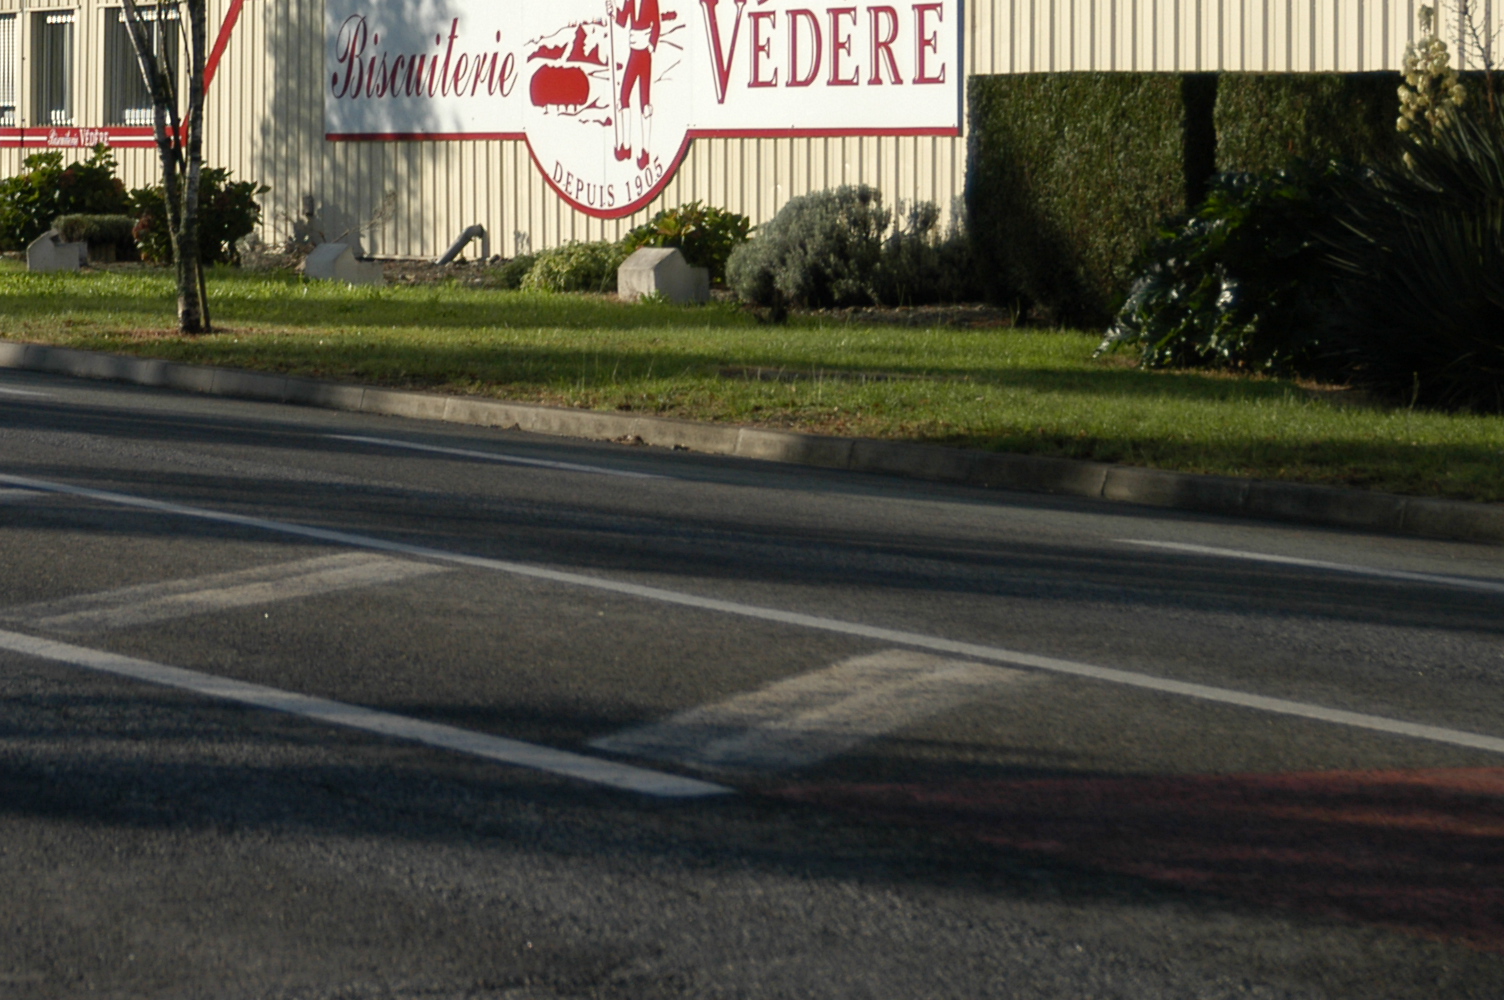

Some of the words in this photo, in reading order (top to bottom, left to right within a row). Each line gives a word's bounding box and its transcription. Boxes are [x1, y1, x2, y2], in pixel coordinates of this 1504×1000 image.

[332, 13, 518, 99] Biscuiterie
[553, 160, 615, 208] DEPUIS
[625, 156, 663, 202] 1905
